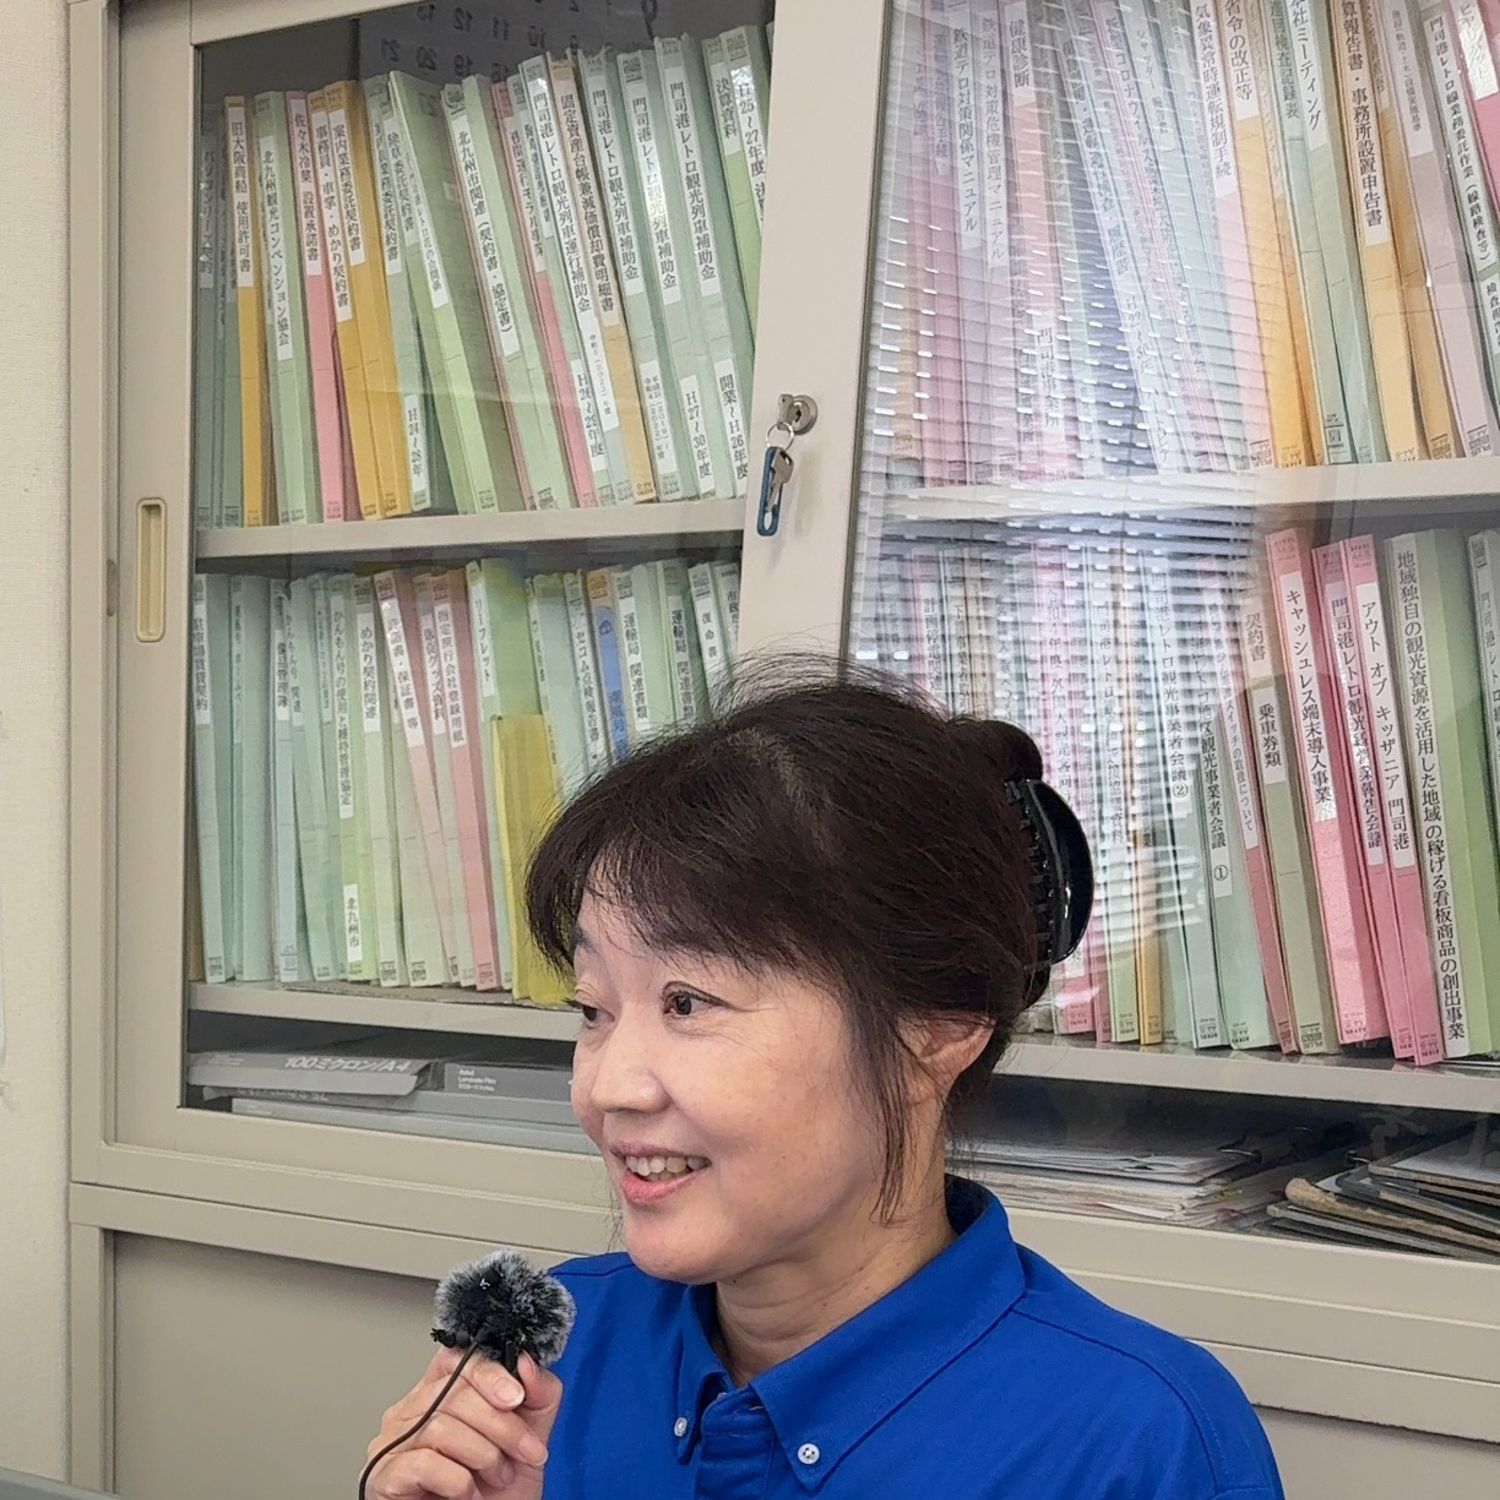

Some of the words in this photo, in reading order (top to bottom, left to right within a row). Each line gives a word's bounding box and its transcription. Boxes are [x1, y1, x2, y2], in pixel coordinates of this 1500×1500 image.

[1010, 19, 1031, 87] 健康診断
[1196, 4, 1232, 179] 気象異常時運転規制手続
[1226, 0, 1253, 100] 省令の改正等
[716, 80, 738, 139] 決算資料
[954, 28, 977, 232] 鉄道テロ対策関係マニュアル
[983, 17, 1005, 260] 鉄道テロ対策危機管理マニュアル
[1429, 17, 1490, 262] 門司港レトロ線業務委託作業（線路検査等）
[231, 121, 248, 194] 旧大阪商船
[533, 92, 593, 313] 門司港レトロ観光列車運行補助金
[593, 89, 639, 281] 門司港レトロ観光列車補助金
[632, 97, 678, 290] 門司港レトロ観光列車補助金
[670, 82, 716, 281] 門司港レトロ観光列車補助金
[236, 201, 251, 273] 使用許可書
[262, 150, 290, 347] 北九州観光コンベンション協会
[458, 129, 513, 334] 北九州市関連（契約書・協定書）
[560, 94, 615, 313] 固定資産台帳兼減価償却費明細書
[686, 391, 711, 479] H27～30年度
[720, 374, 748, 480] 開業～H26年度
[475, 599, 491, 683] リーフレット
[624, 612, 639, 656] 運輸局
[672, 609, 687, 653] 運輸局
[702, 612, 717, 658] 復命書
[1246, 612, 1267, 662] 契約書
[1361, 601, 1381, 652] アウト
[360, 626, 378, 720] めかり契約関連
[1287, 590, 1332, 804] キャッシュレス端末導入事業
[1369, 662, 1388, 697] オブ
[1258, 703, 1282, 768] 乗車券類
[1376, 706, 1400, 790] キッザニア
[1388, 797, 1410, 851] 門司港
[1397, 550, 1465, 1040] 地域独自の観光資源を活用した地域の稼げる看板商品の創出事業
[348, 897, 360, 948] 北九州市
